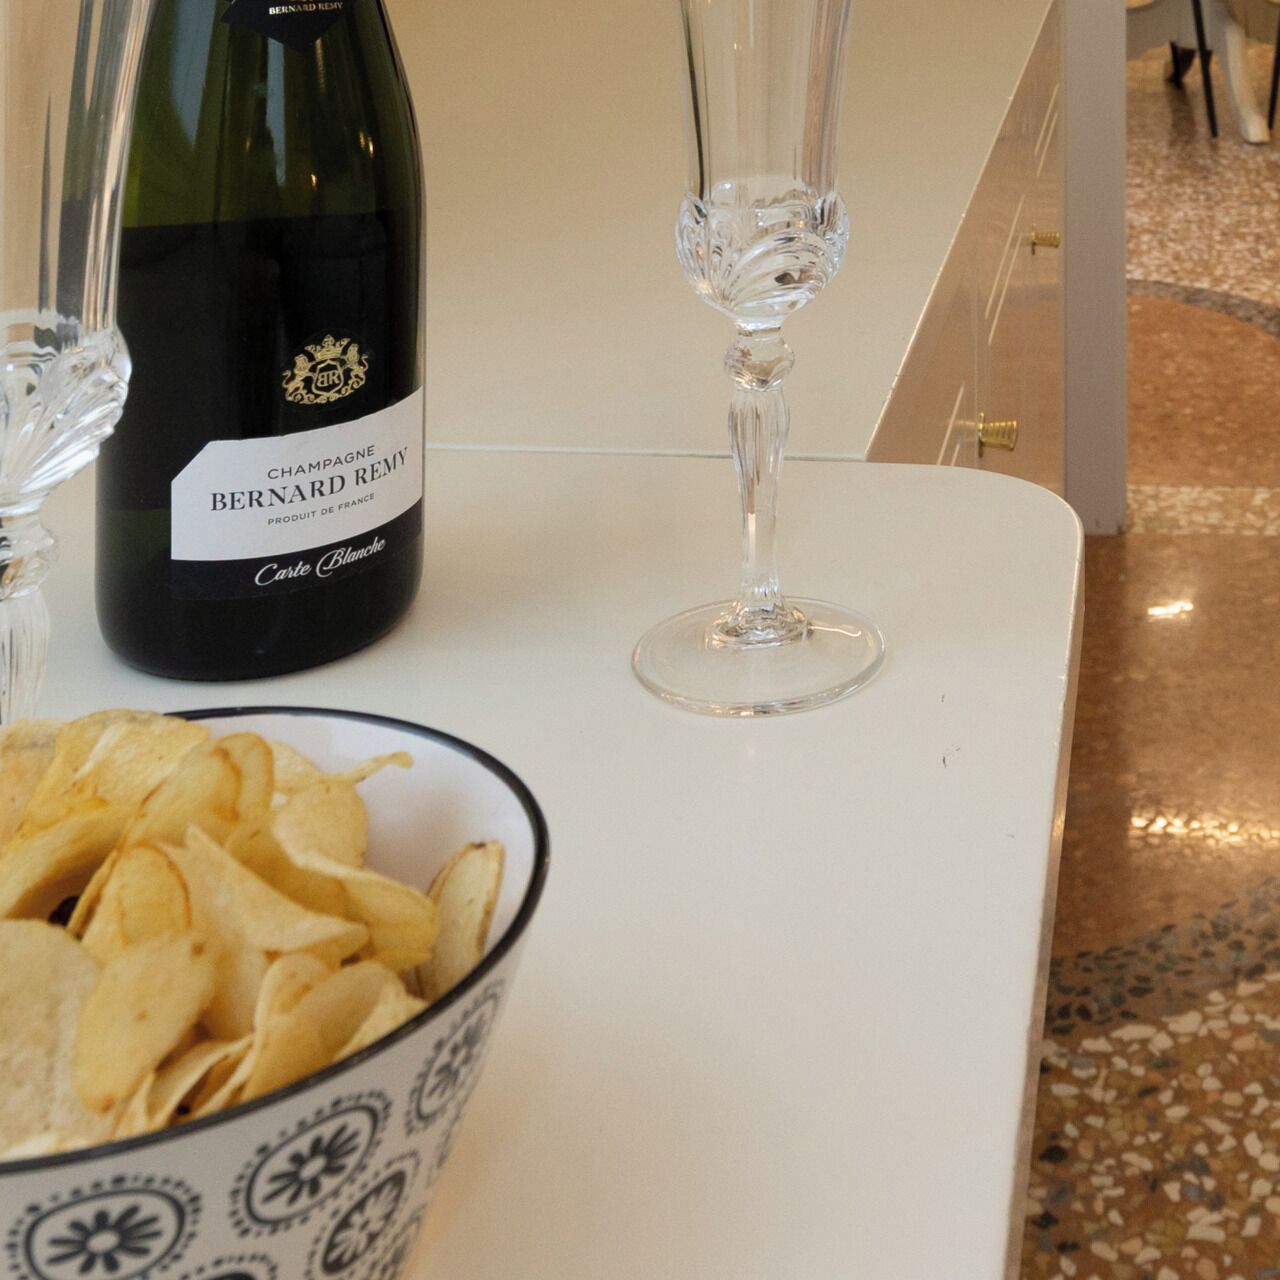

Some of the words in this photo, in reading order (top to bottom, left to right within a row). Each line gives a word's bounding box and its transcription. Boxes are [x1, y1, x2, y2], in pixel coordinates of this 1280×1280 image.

[268, 2, 317, 15] BERNARD
[318, 1, 344, 11] REMY
[210, 474, 346, 512] BERNARD
[353, 446, 409, 487] REMY
[267, 445, 375, 480] CHAMPAGNE
[267, 510, 318, 526] PRODUIT
[320, 506, 335, 516] DE
[338, 492, 375, 512] FRANCE
[254, 561, 312, 586] Carte
[316, 536, 387, 578] Blanche
